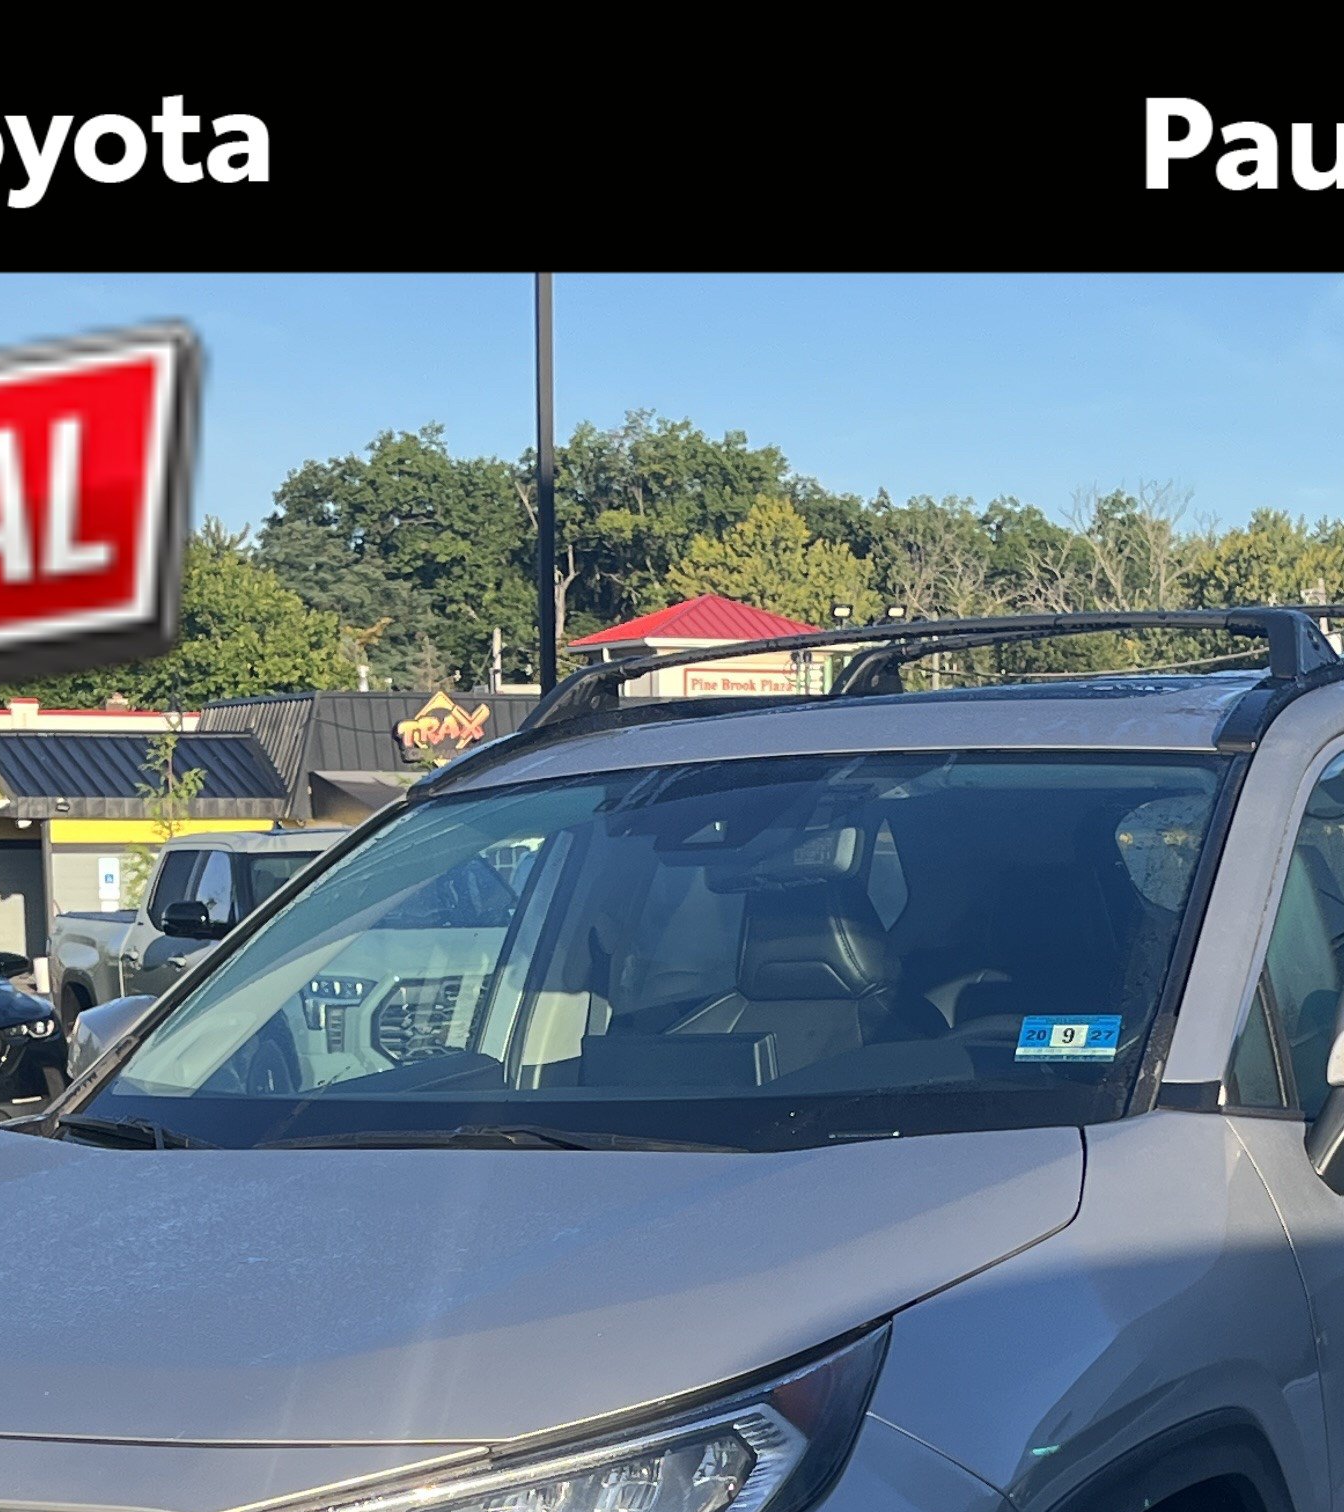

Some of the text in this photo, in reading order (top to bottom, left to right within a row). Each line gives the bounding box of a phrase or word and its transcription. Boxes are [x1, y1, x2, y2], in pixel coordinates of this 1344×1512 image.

[691, 678, 718, 691] Pine
[721, 678, 757, 692] Brook
[397, 703, 490, 748] TRAX
[1026, 1028, 1115, 1044] 20 9 27
